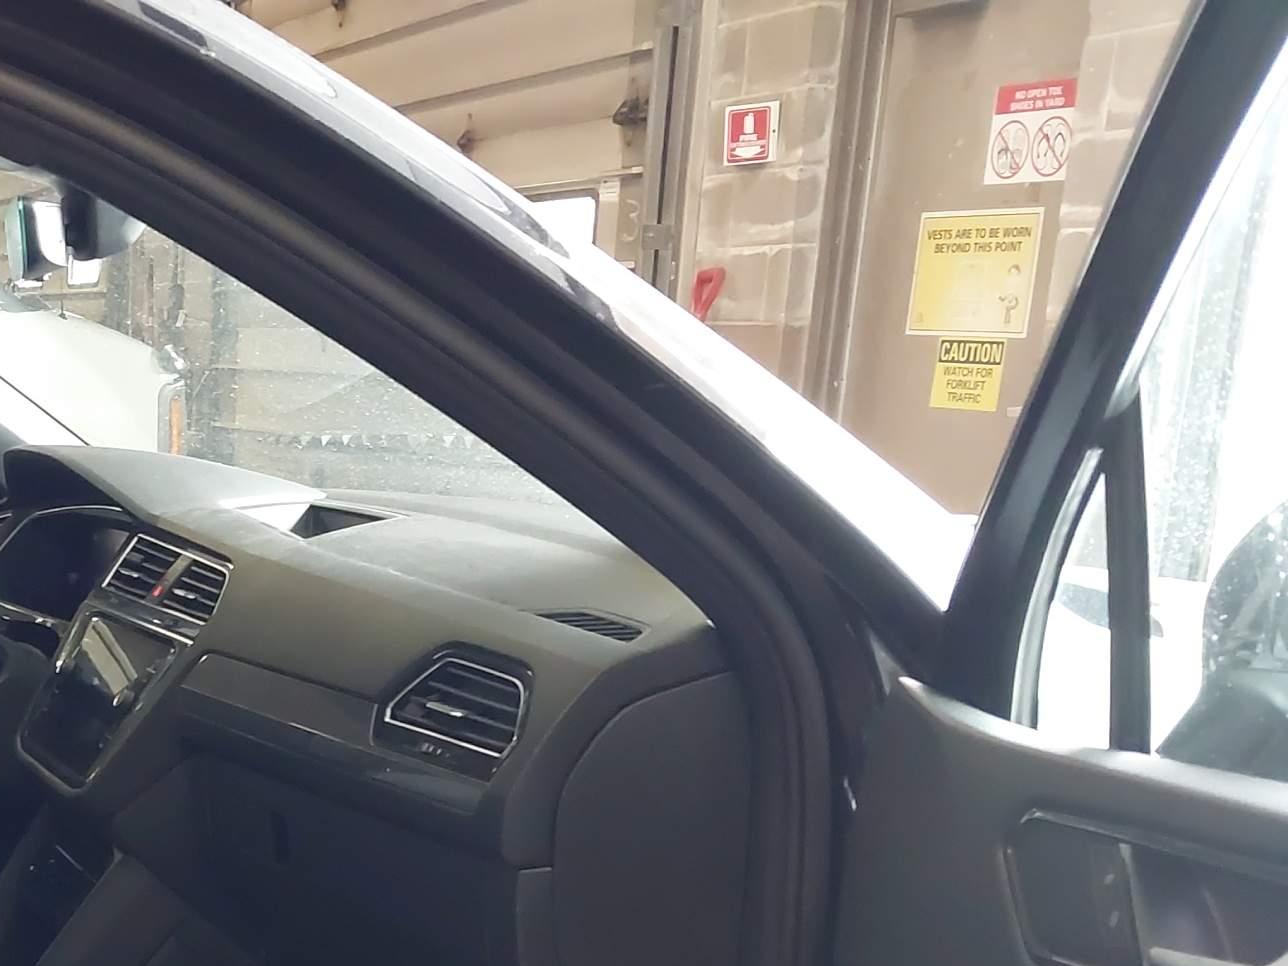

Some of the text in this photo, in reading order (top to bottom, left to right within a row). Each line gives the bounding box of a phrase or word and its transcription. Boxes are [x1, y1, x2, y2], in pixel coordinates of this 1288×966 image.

[927, 226, 1032, 241] VESTS ARE TO BE WORN
[934, 241, 1023, 254] BEYOND THIS POINT
[940, 341, 1003, 363] CAUTION
[943, 366, 993, 378] WATCH FOR
[946, 379, 986, 391] FORKLIFT
[947, 391, 982, 404] TRAFFIC
